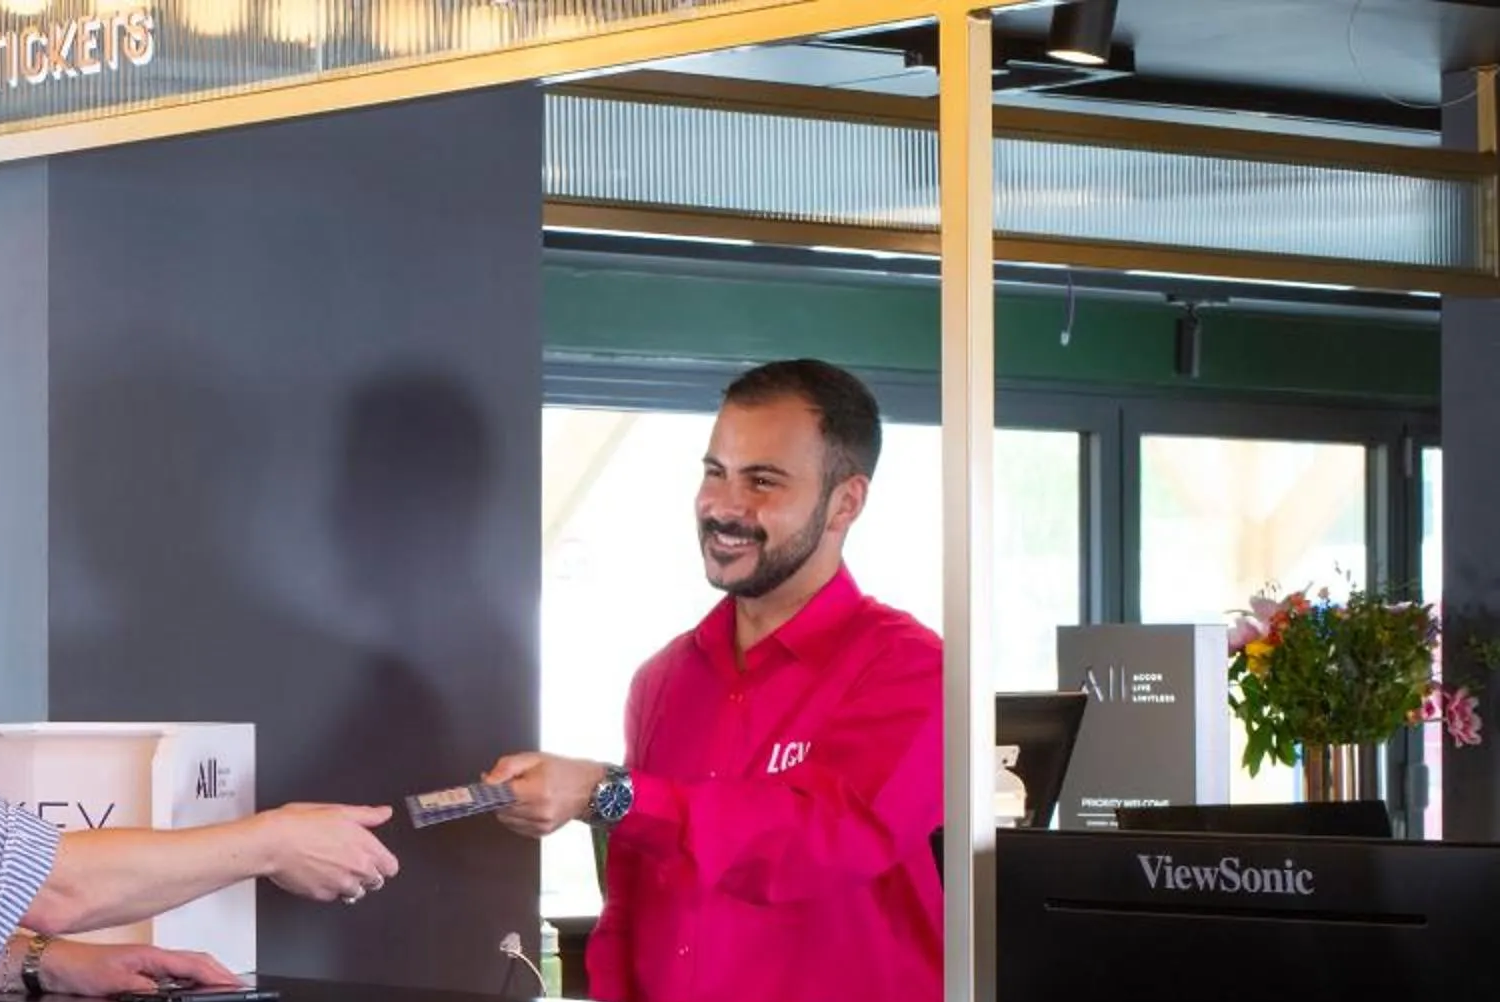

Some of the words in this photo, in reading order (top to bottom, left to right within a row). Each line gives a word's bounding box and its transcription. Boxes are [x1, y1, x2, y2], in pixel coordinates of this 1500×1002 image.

[1132, 684, 1151, 692] LIVE
[1132, 694, 1175, 703] LIMITLESS
[1136, 854, 1315, 895] ViewSonic
